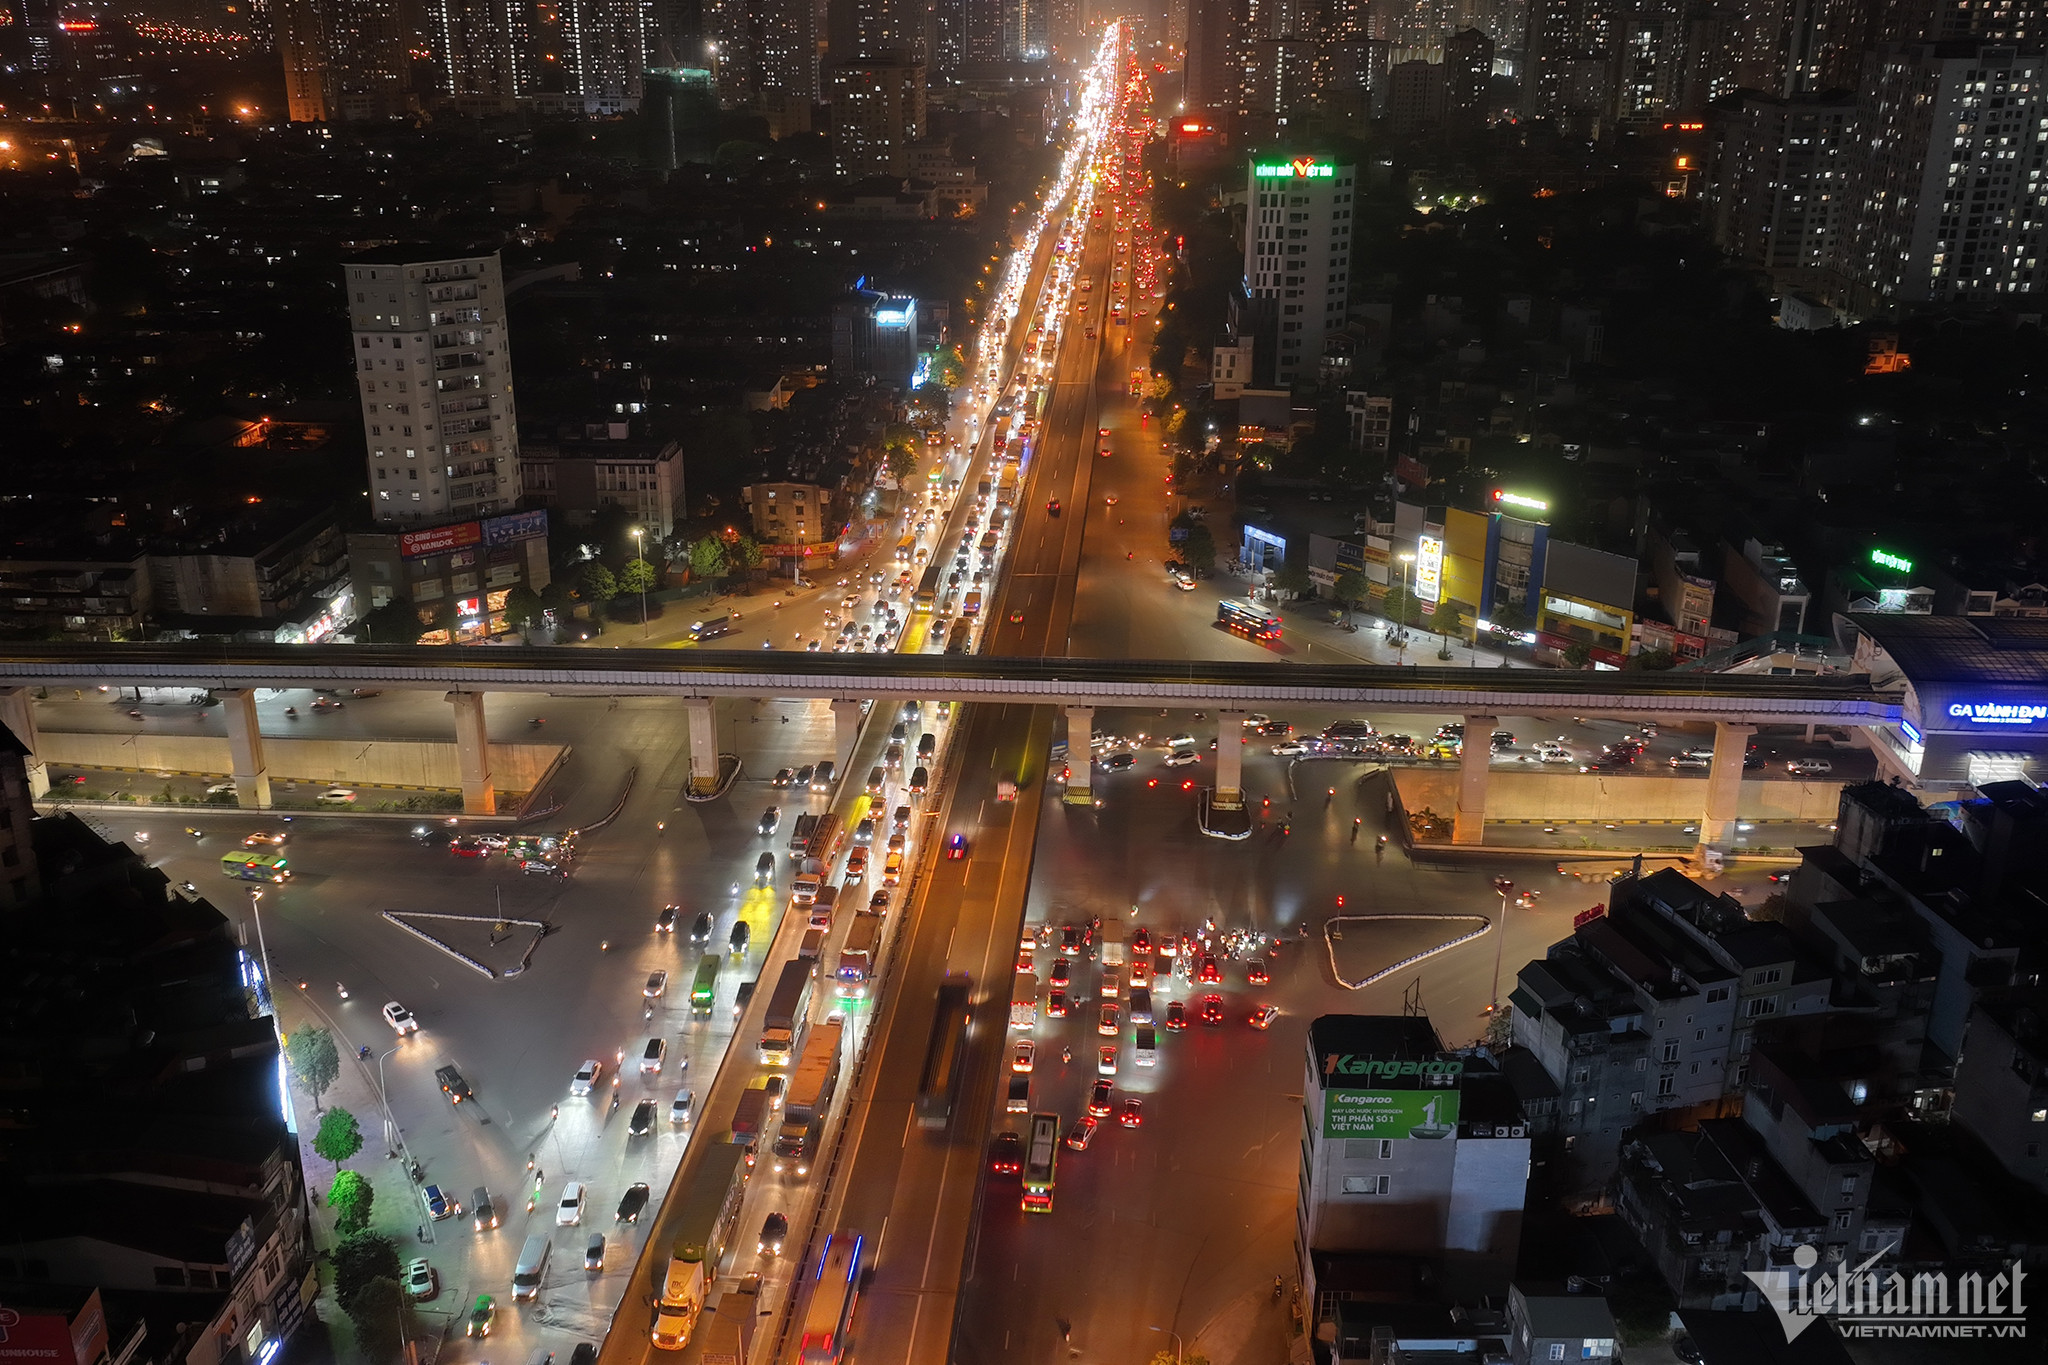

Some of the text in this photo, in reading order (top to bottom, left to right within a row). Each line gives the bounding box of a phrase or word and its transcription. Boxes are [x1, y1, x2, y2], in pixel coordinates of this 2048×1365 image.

[1949, 702, 2046, 718] GA VÀNH ĐAI
[1332, 1115, 1347, 1124] THỊ
[1348, 1114, 1374, 1122] PHẦN
[1375, 1114, 1388, 1122] SỐ
[1331, 1122, 1374, 1132] VIỆT NAM
